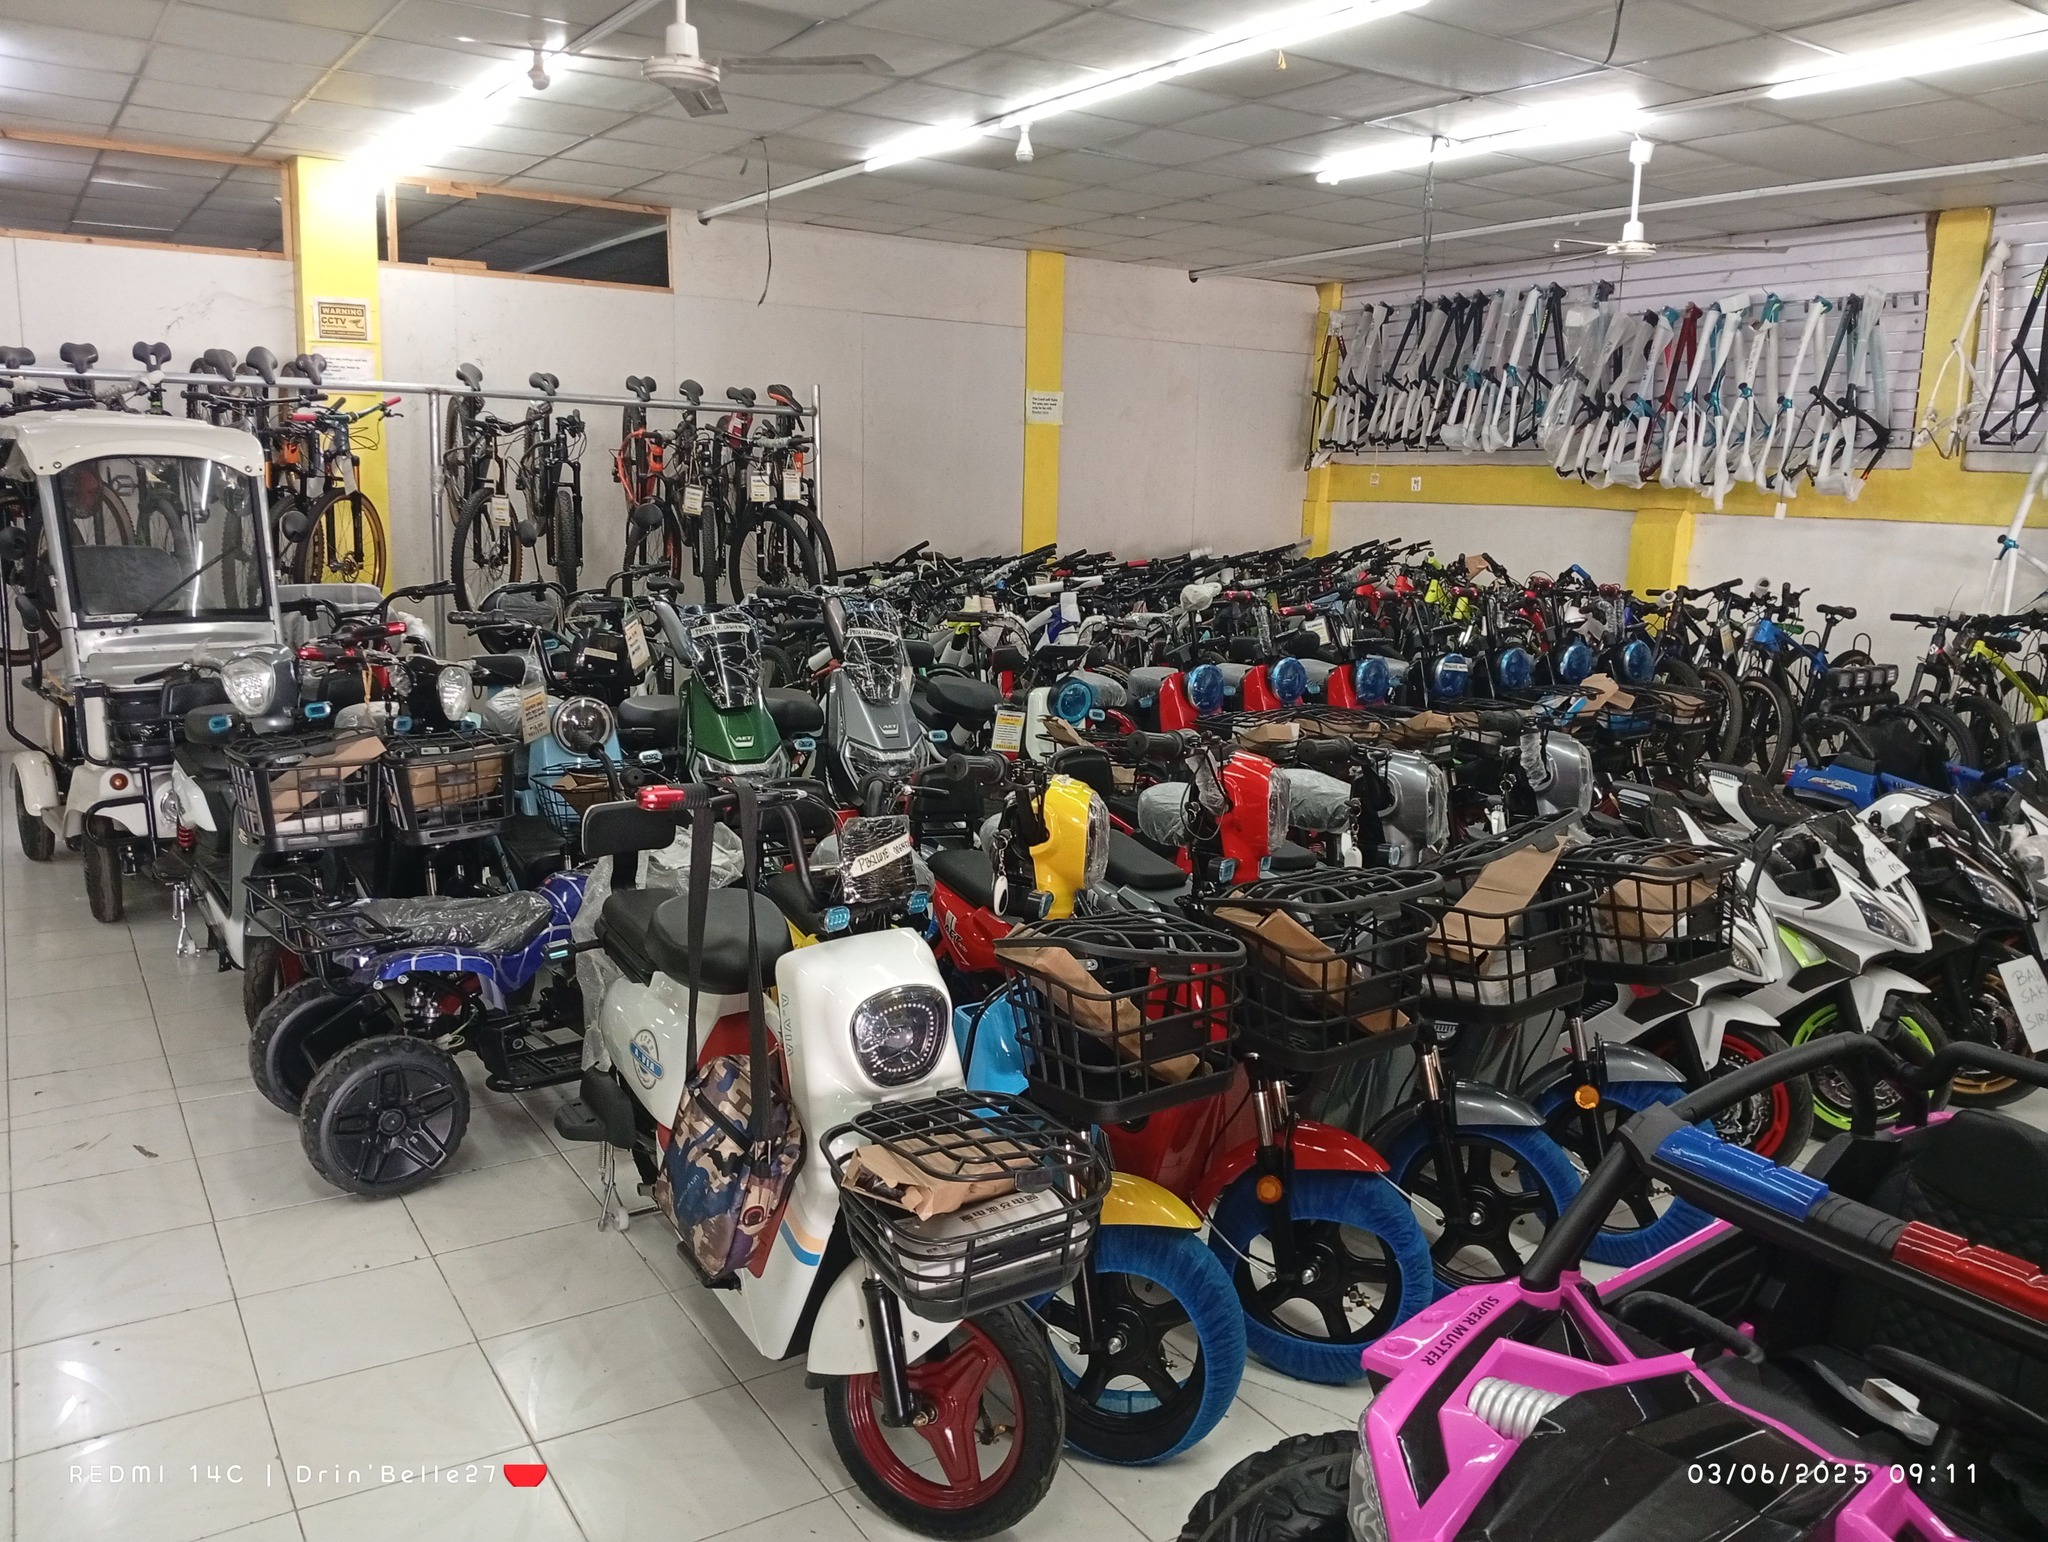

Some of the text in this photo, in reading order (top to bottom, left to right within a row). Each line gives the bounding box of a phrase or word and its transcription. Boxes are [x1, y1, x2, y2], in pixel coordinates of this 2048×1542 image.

[321, 307, 363, 316] WARNING
[321, 317, 346, 325] CCTV
[634, 1048, 655, 1072] A.VIA
[1420, 1295, 1500, 1366] SUPER MUSTER
